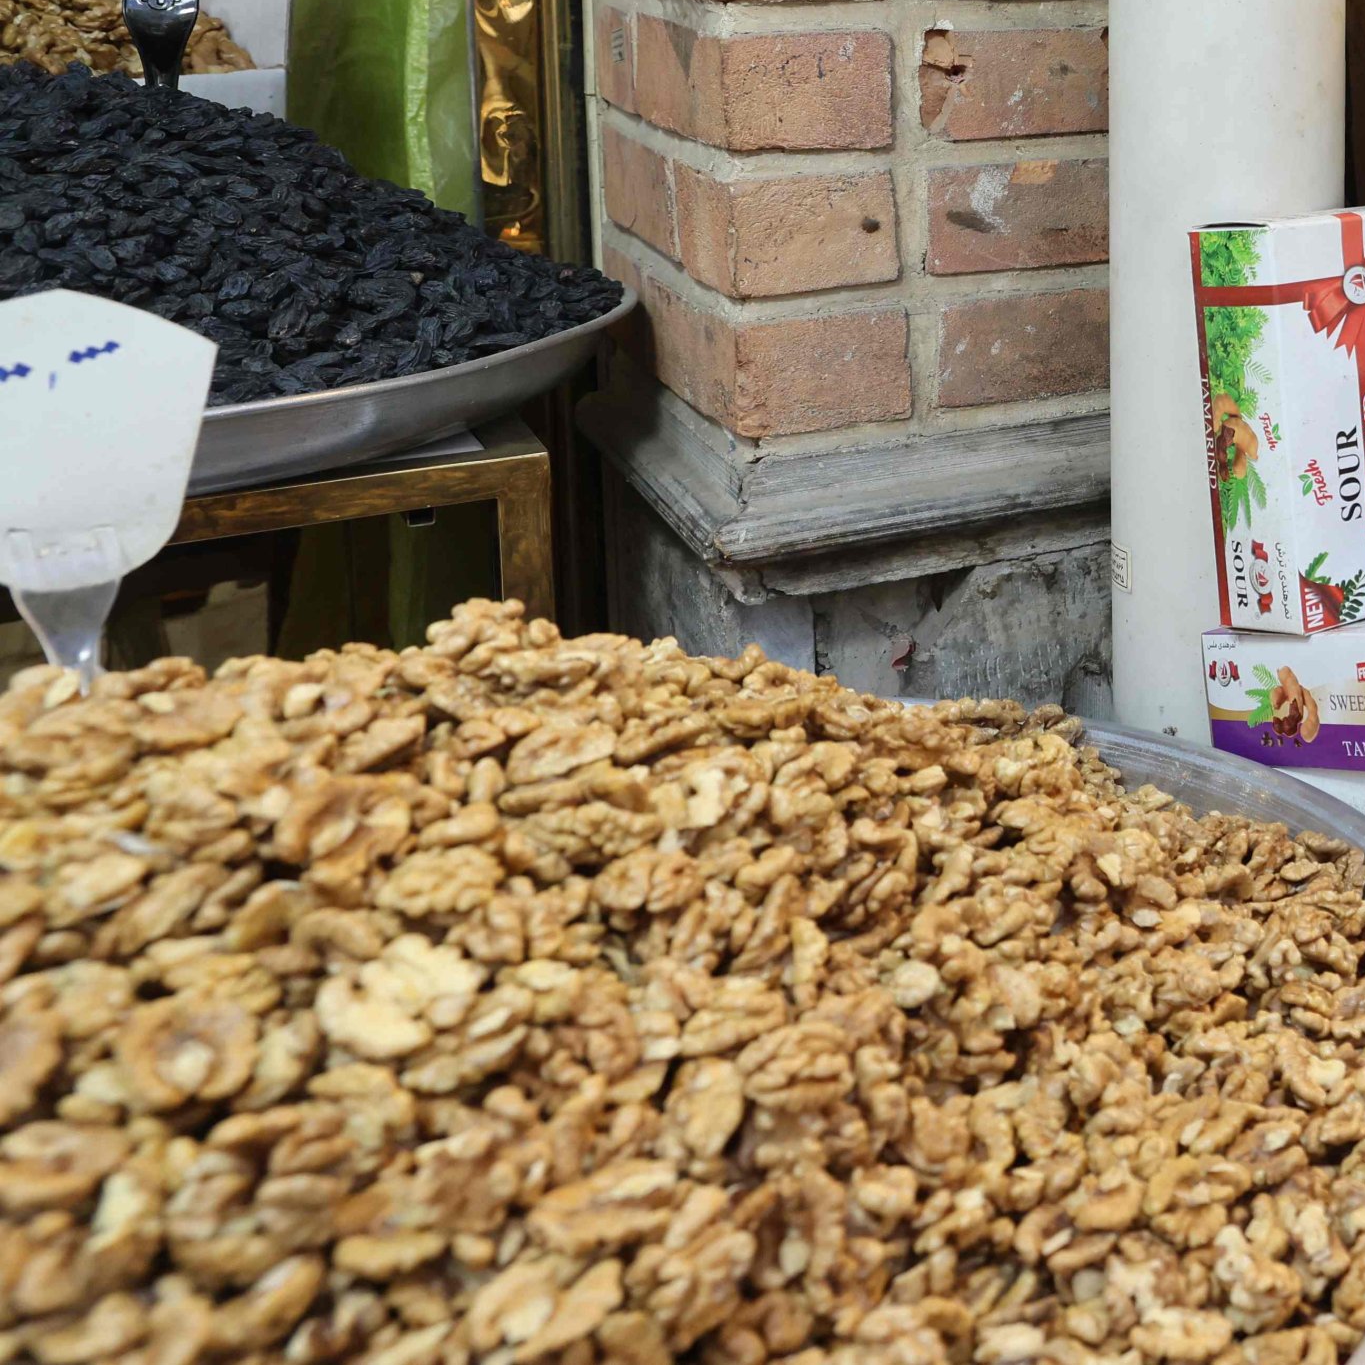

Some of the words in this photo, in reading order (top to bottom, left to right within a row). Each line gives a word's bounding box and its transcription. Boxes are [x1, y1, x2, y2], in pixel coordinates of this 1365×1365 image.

[1200, 376, 1219, 491] TAMARIND
[1258, 412, 1278, 452] Fresh
[1309, 459, 1334, 506] Fresh
[1335, 426, 1363, 524] SOUR
[1231, 540, 1249, 609] SOUR
[1306, 586, 1325, 629] NEW
